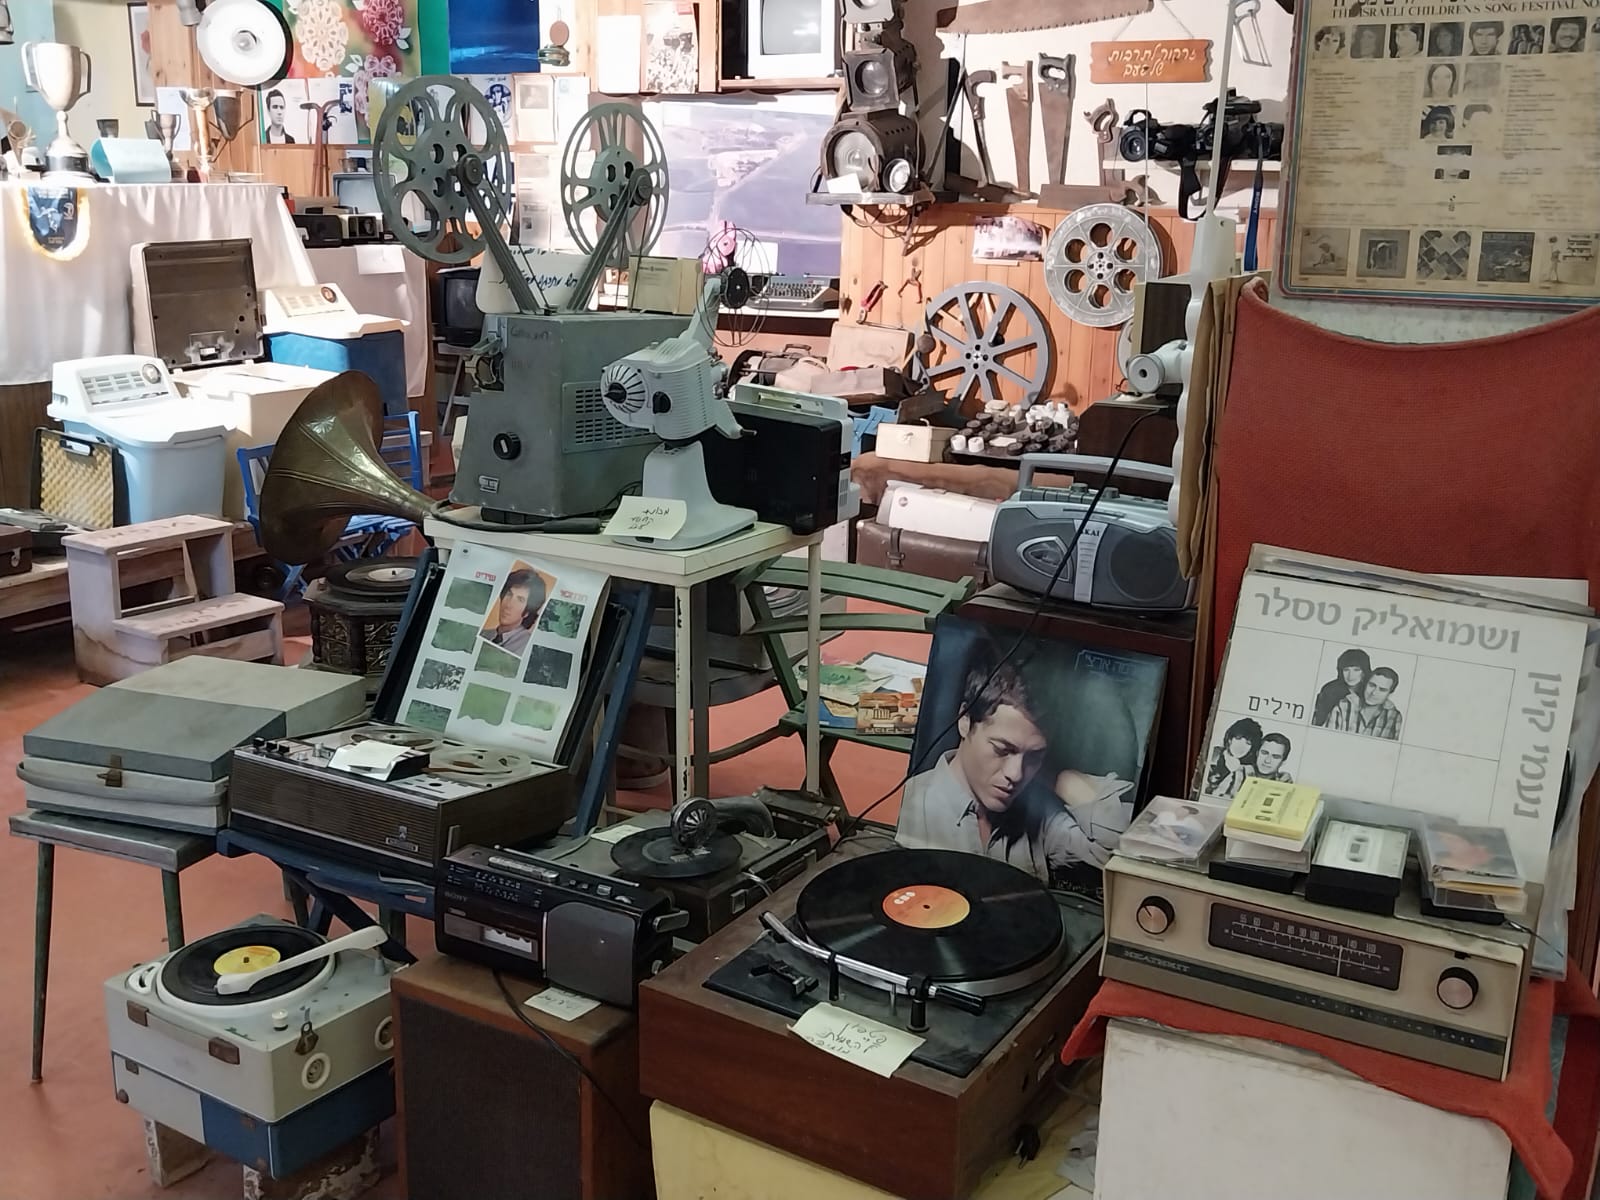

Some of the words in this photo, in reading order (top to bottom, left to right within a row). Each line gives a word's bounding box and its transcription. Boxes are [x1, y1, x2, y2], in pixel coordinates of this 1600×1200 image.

[1485, 3, 1517, 13] SONG
[1254, 586, 1342, 625] טסלר
[1352, 604, 1521, 654] ושמואליק
[1247, 695, 1306, 721] מילים
[1521, 671, 1563, 735] קינן
[1512, 744, 1551, 819] נעמי
